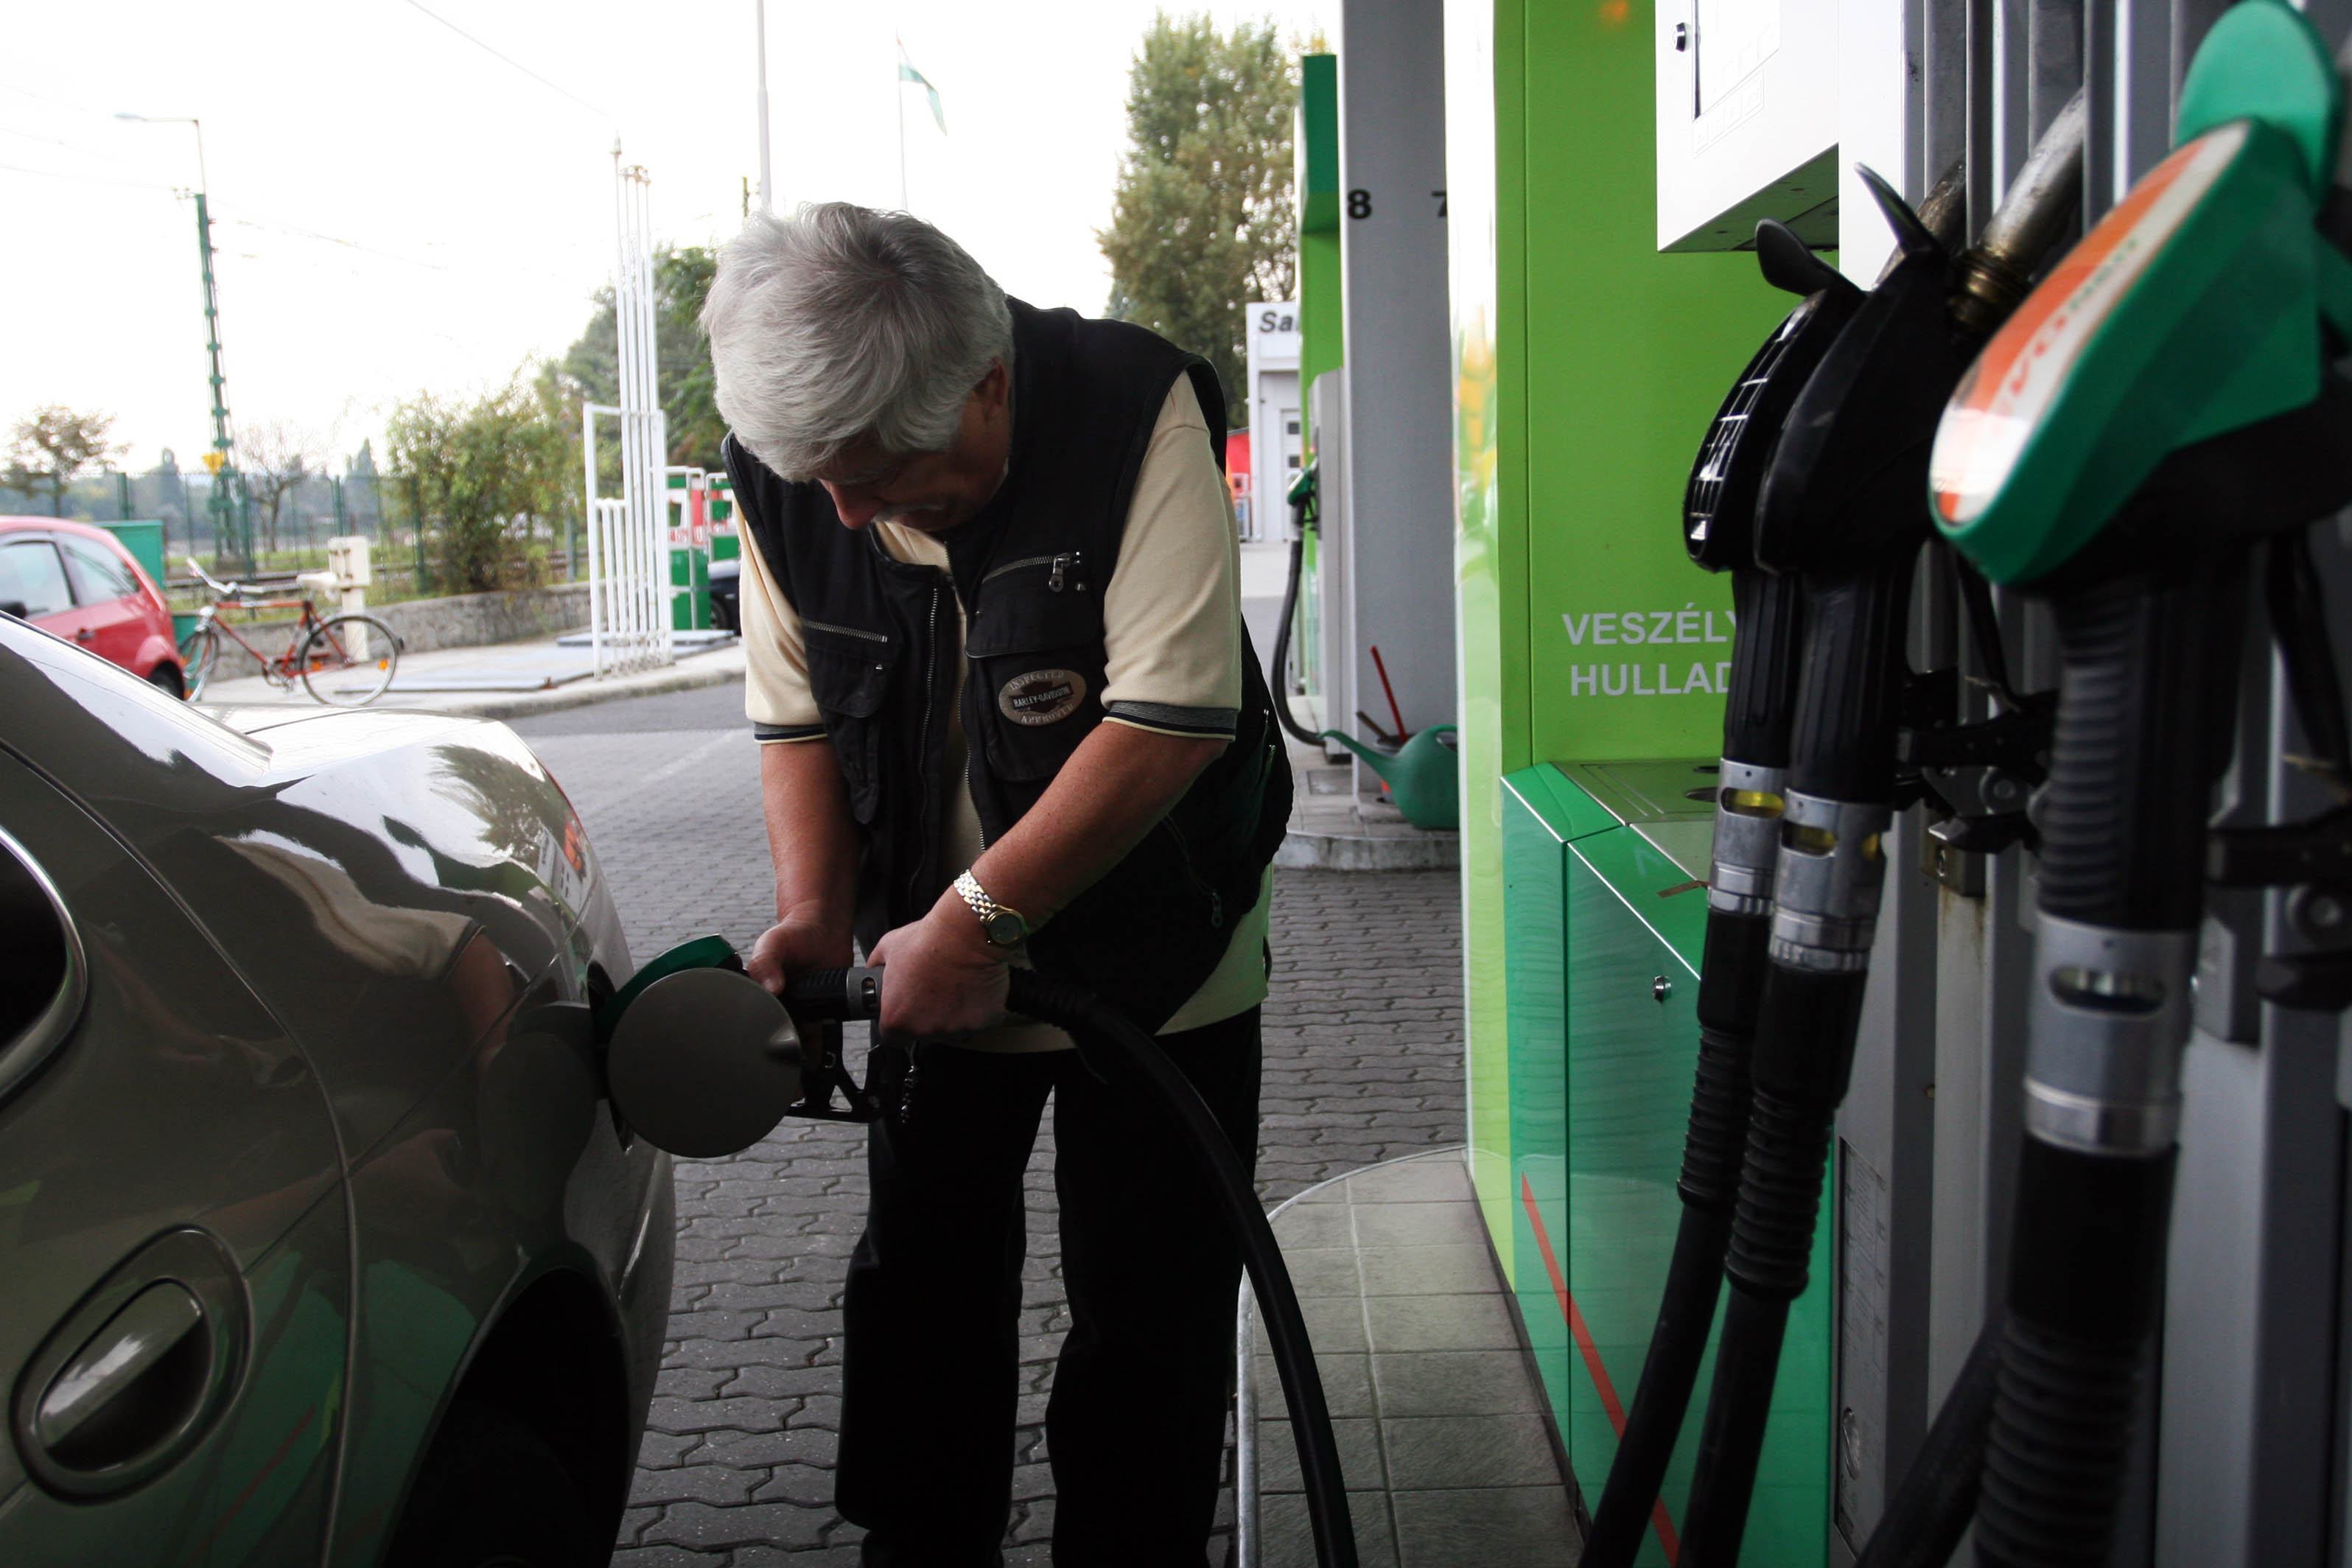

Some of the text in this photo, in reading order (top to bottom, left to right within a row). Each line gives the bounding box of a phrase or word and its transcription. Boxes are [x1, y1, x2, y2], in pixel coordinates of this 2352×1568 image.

[1348, 189, 1373, 219] 8
[1259, 311, 1297, 333] Sa
[1013, 685, 1071, 707] HARLEY-DAVIDSON
